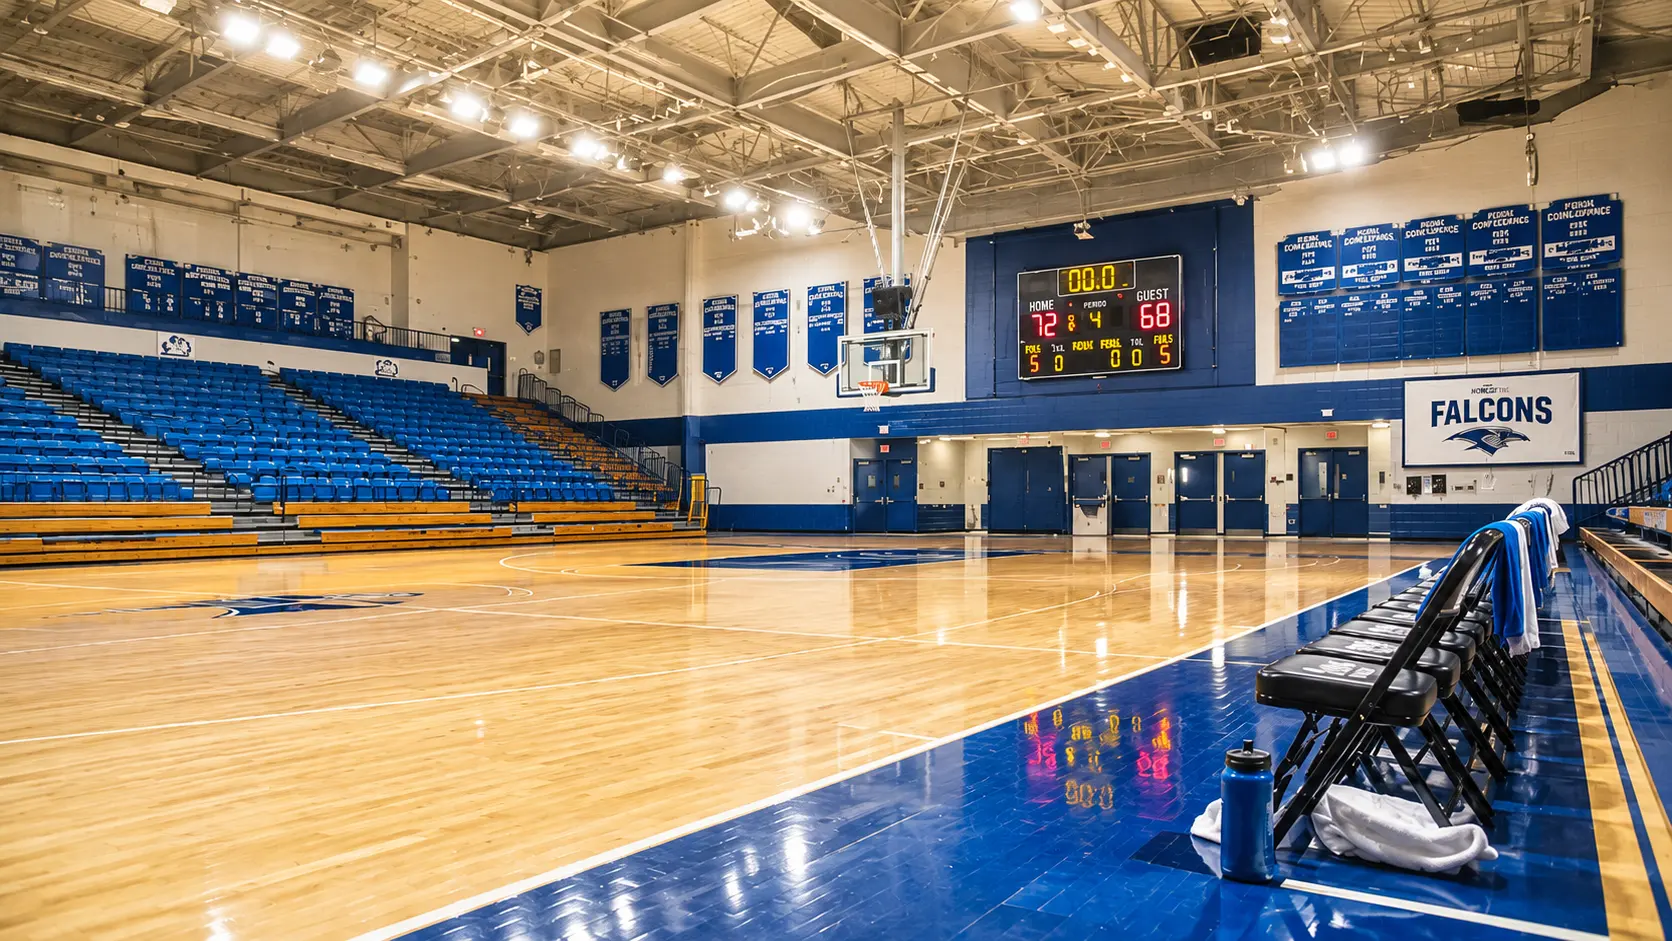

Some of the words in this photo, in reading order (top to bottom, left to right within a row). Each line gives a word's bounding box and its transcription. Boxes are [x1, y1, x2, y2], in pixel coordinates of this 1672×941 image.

[1068, 265, 1115, 293] 00.0
[1136, 288, 1169, 302] GUEST
[1029, 299, 1054, 312] HOME
[1031, 312, 1057, 336] 72
[1089, 310, 1101, 329] 4
[1140, 302, 1171, 329] 68
[1030, 354, 1039, 372] 5
[1054, 354, 1064, 371] 0
[1110, 349, 1121, 368] 0
[1131, 348, 1142, 367] 0
[1160, 344, 1171, 364] 5
[1431, 396, 1553, 427] FALCONS
